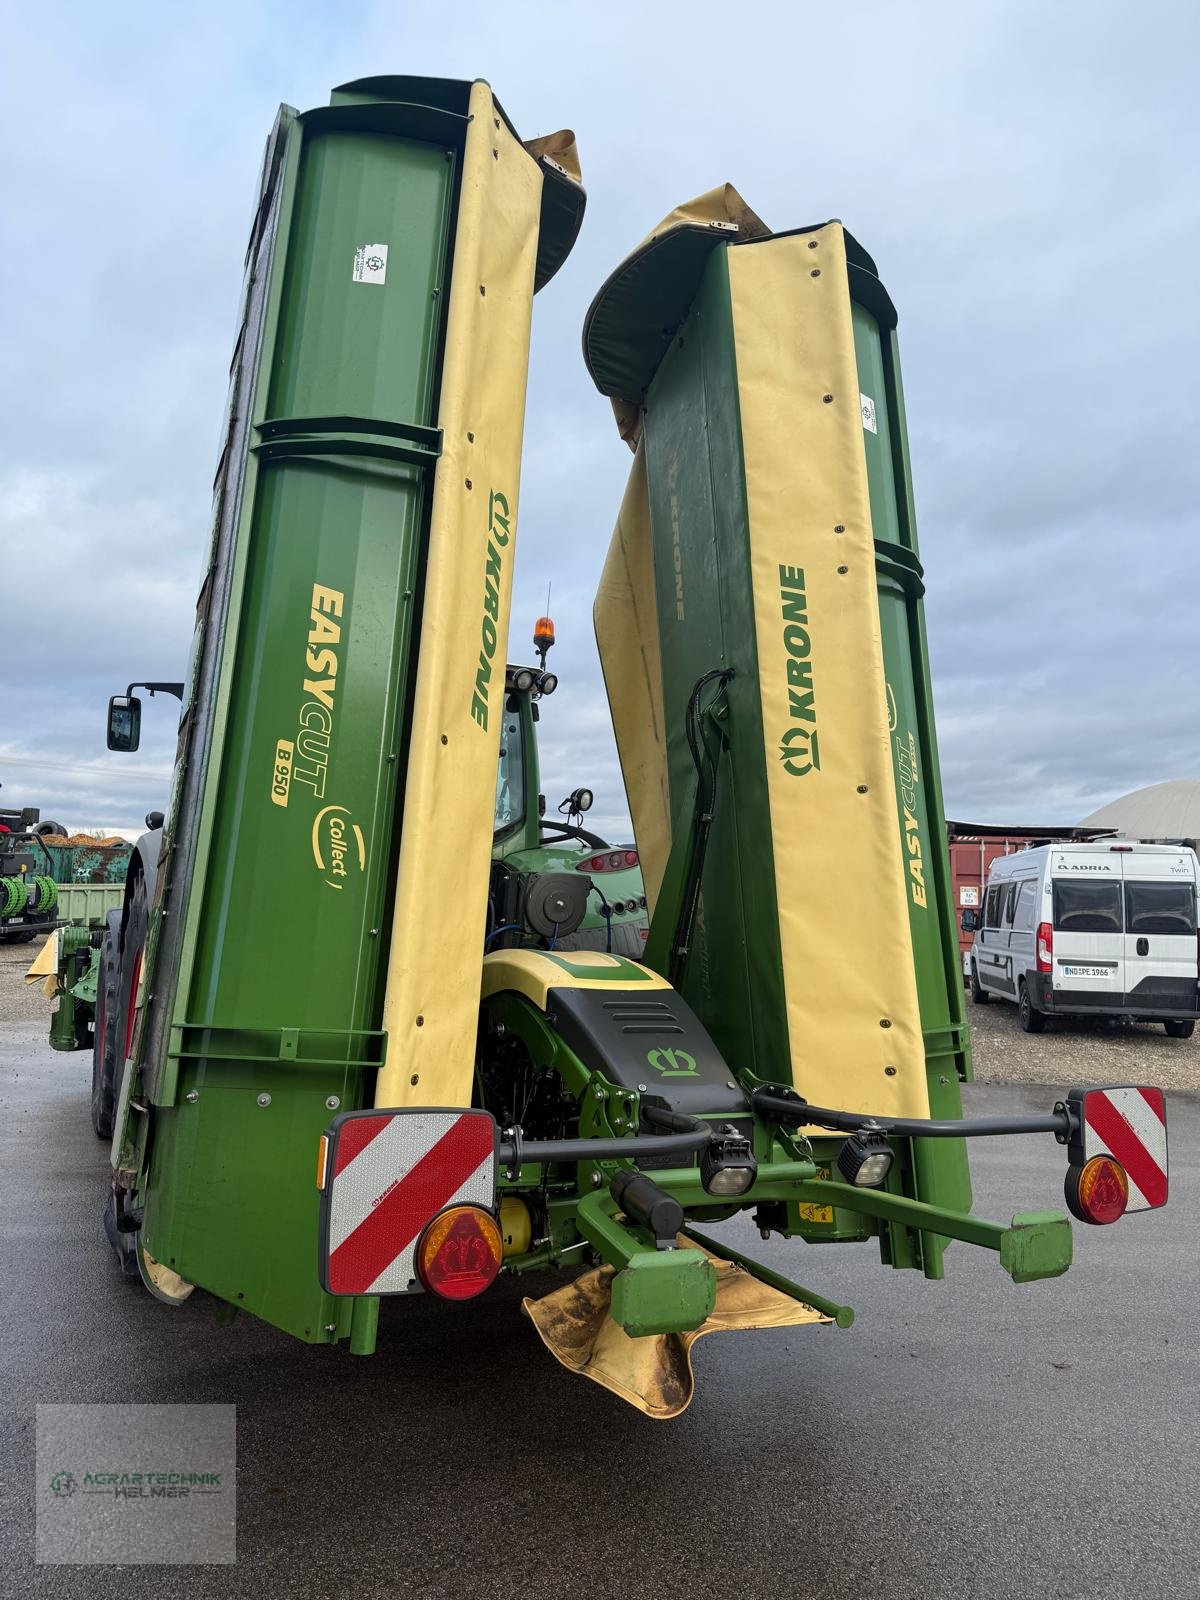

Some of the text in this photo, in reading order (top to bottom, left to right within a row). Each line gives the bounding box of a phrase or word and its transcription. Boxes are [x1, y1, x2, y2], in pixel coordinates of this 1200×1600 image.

[470, 539, 502, 733] KRONE
[779, 563, 817, 723] KRONE
[273, 747, 291, 797] B 950
[328, 817, 348, 877] Collect
